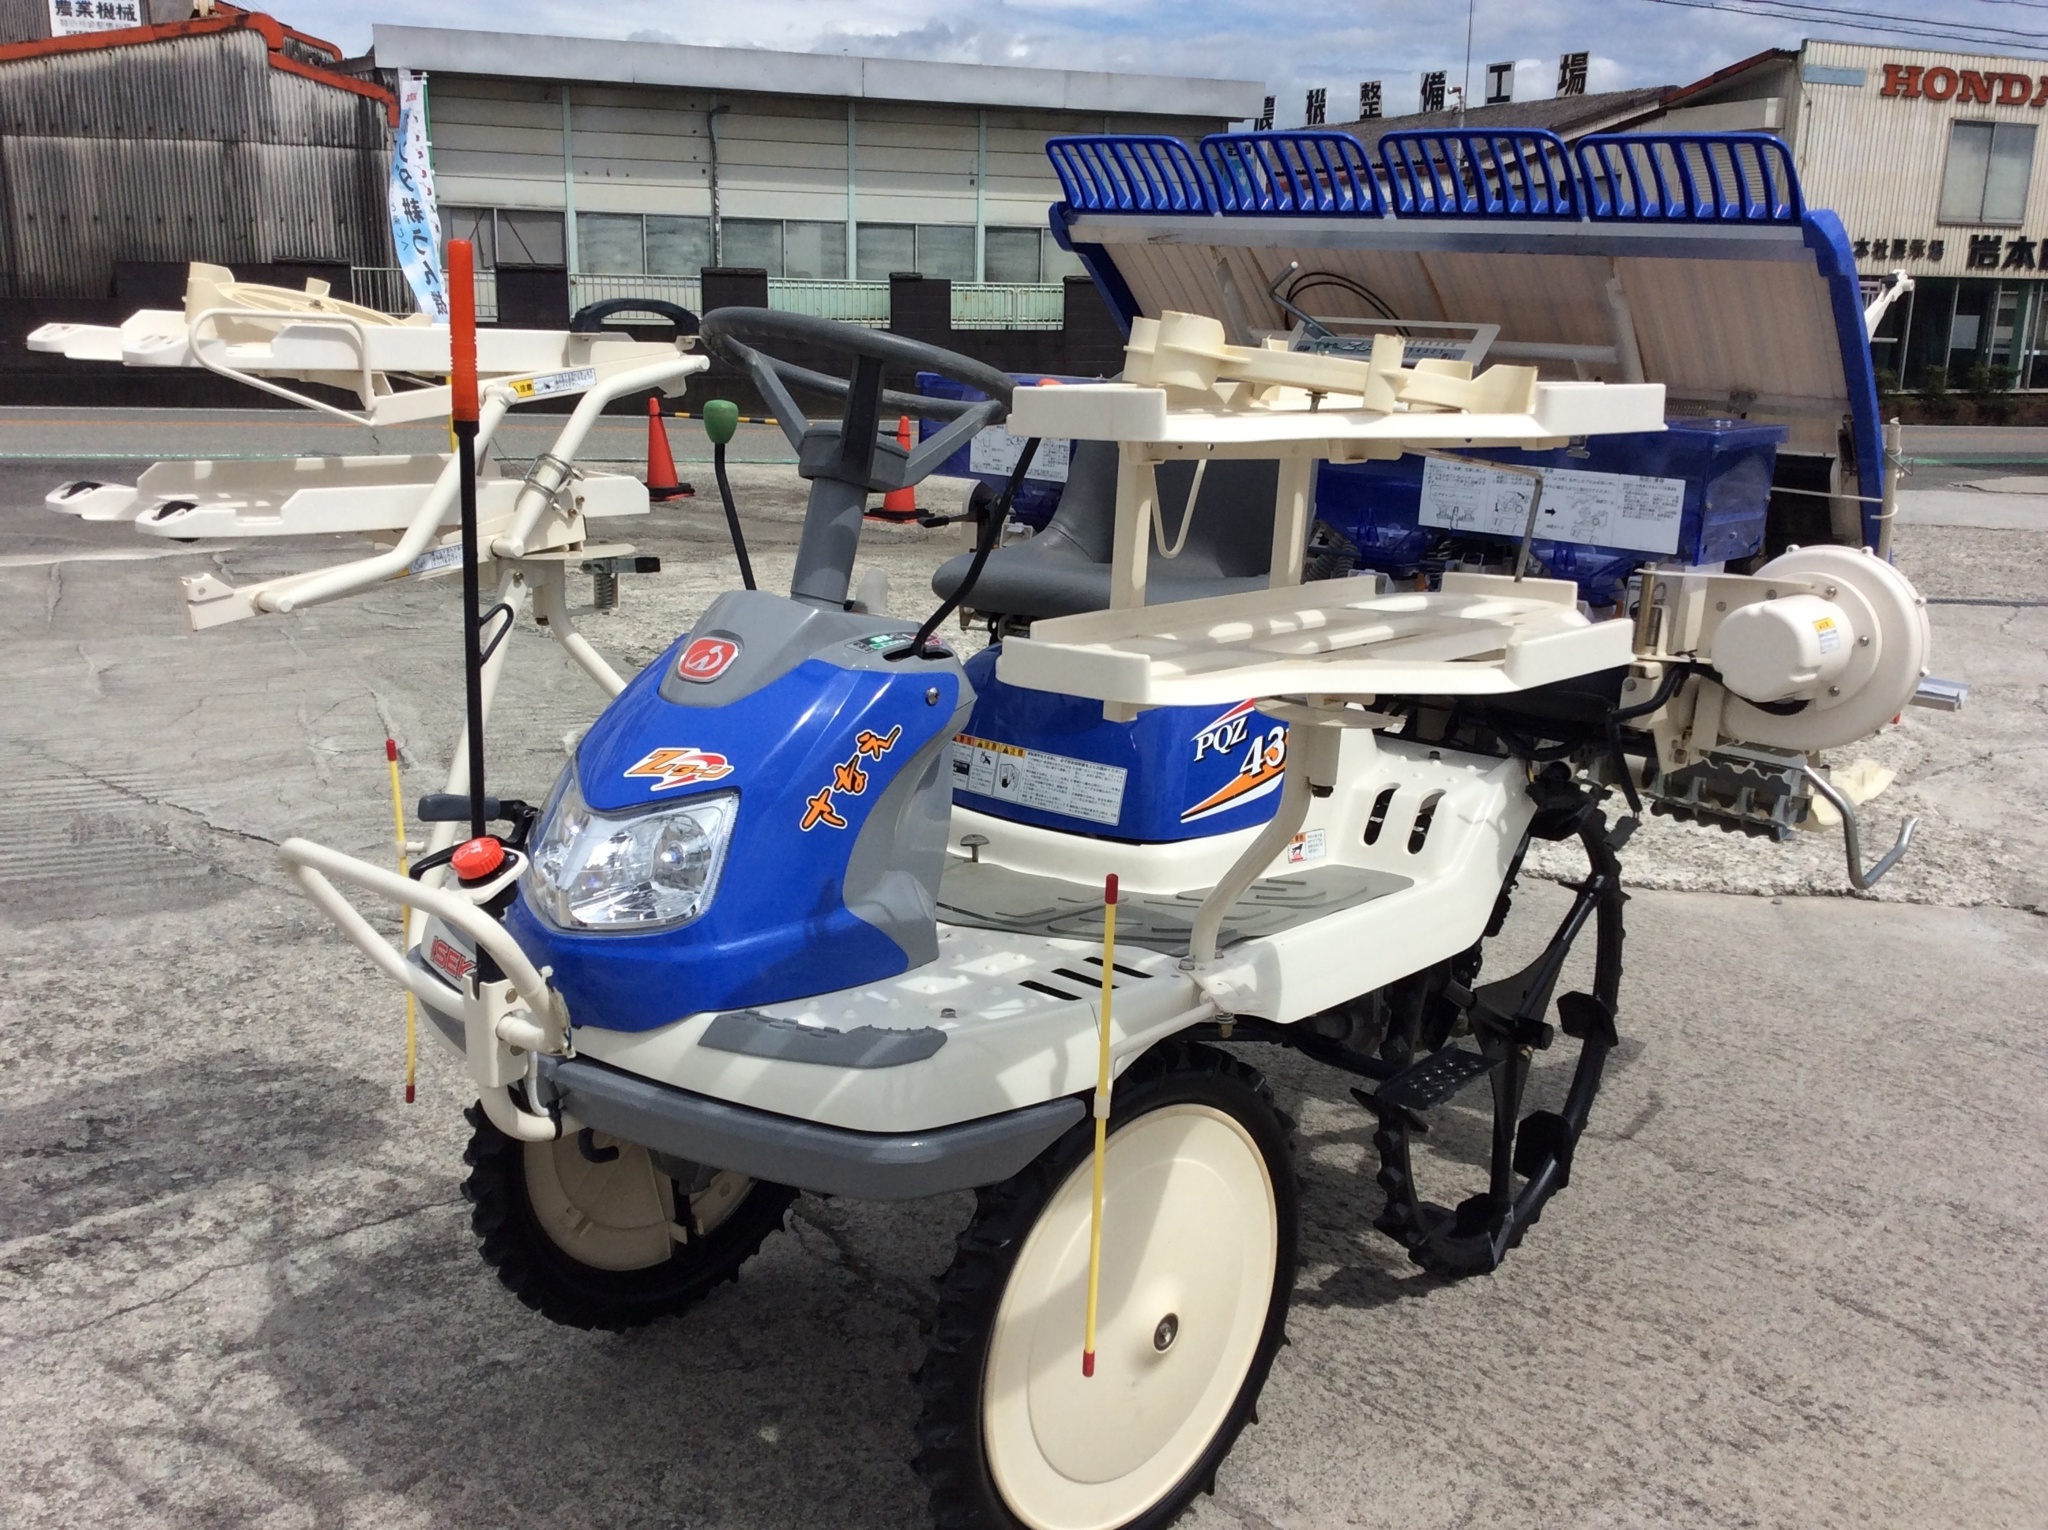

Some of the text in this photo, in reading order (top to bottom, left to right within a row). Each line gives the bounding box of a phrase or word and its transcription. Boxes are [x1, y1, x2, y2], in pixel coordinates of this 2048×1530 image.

[55, 0, 138, 21] 農業機械
[1966, 234, 2048, 270] 岩本
[1193, 716, 1249, 762] PQZ
[1239, 726, 1285, 777] 43
[430, 935, 477, 981] ISEK
